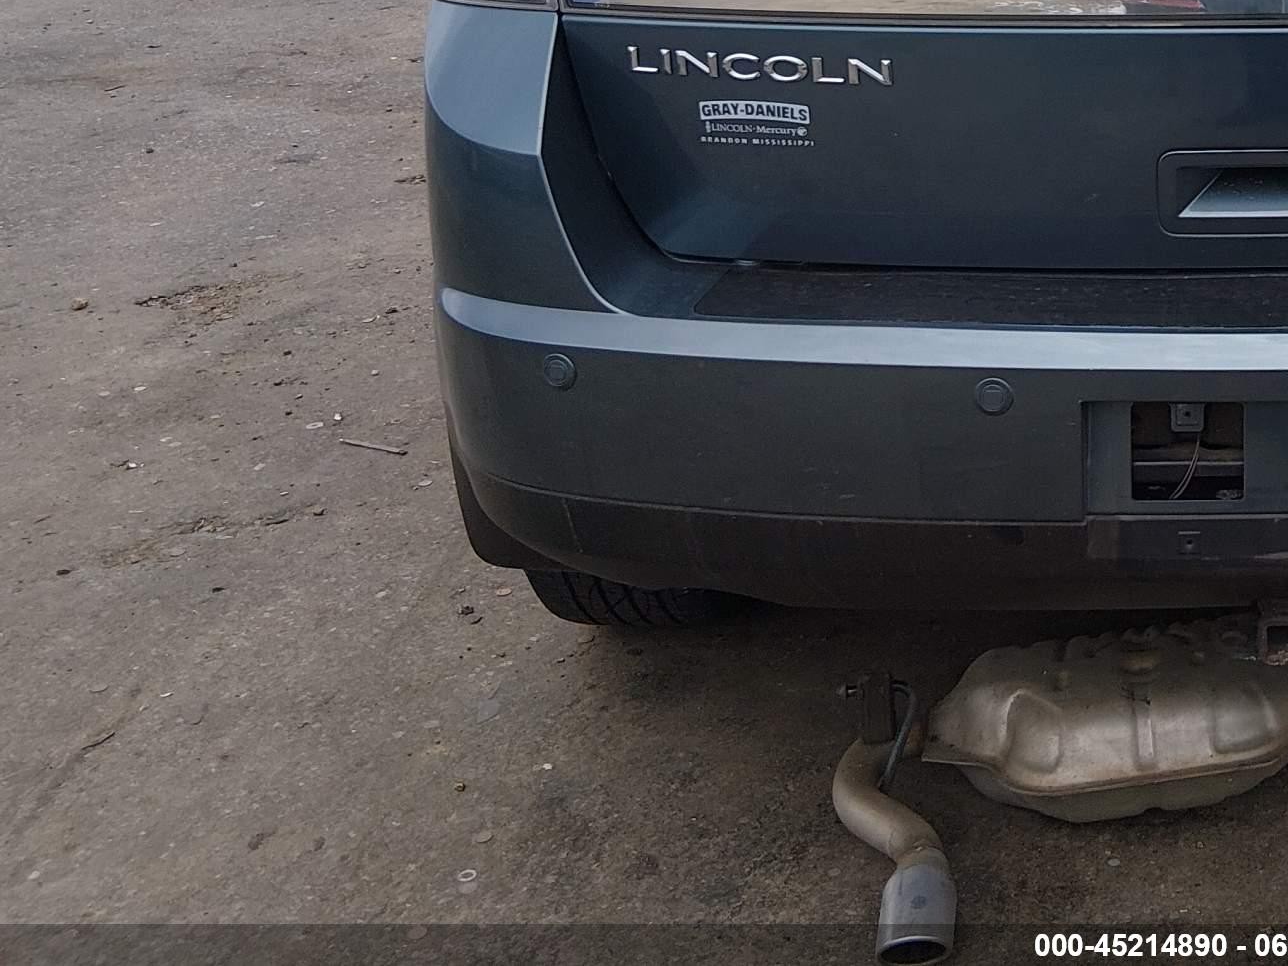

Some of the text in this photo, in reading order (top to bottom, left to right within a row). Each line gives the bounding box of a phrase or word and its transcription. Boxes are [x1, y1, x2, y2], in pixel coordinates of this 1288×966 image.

[627, 45, 894, 86] LINCOLN
[701, 102, 808, 122] GRAY-DANIELS
[700, 136, 815, 147] BRANDON MISSISSIPPI
